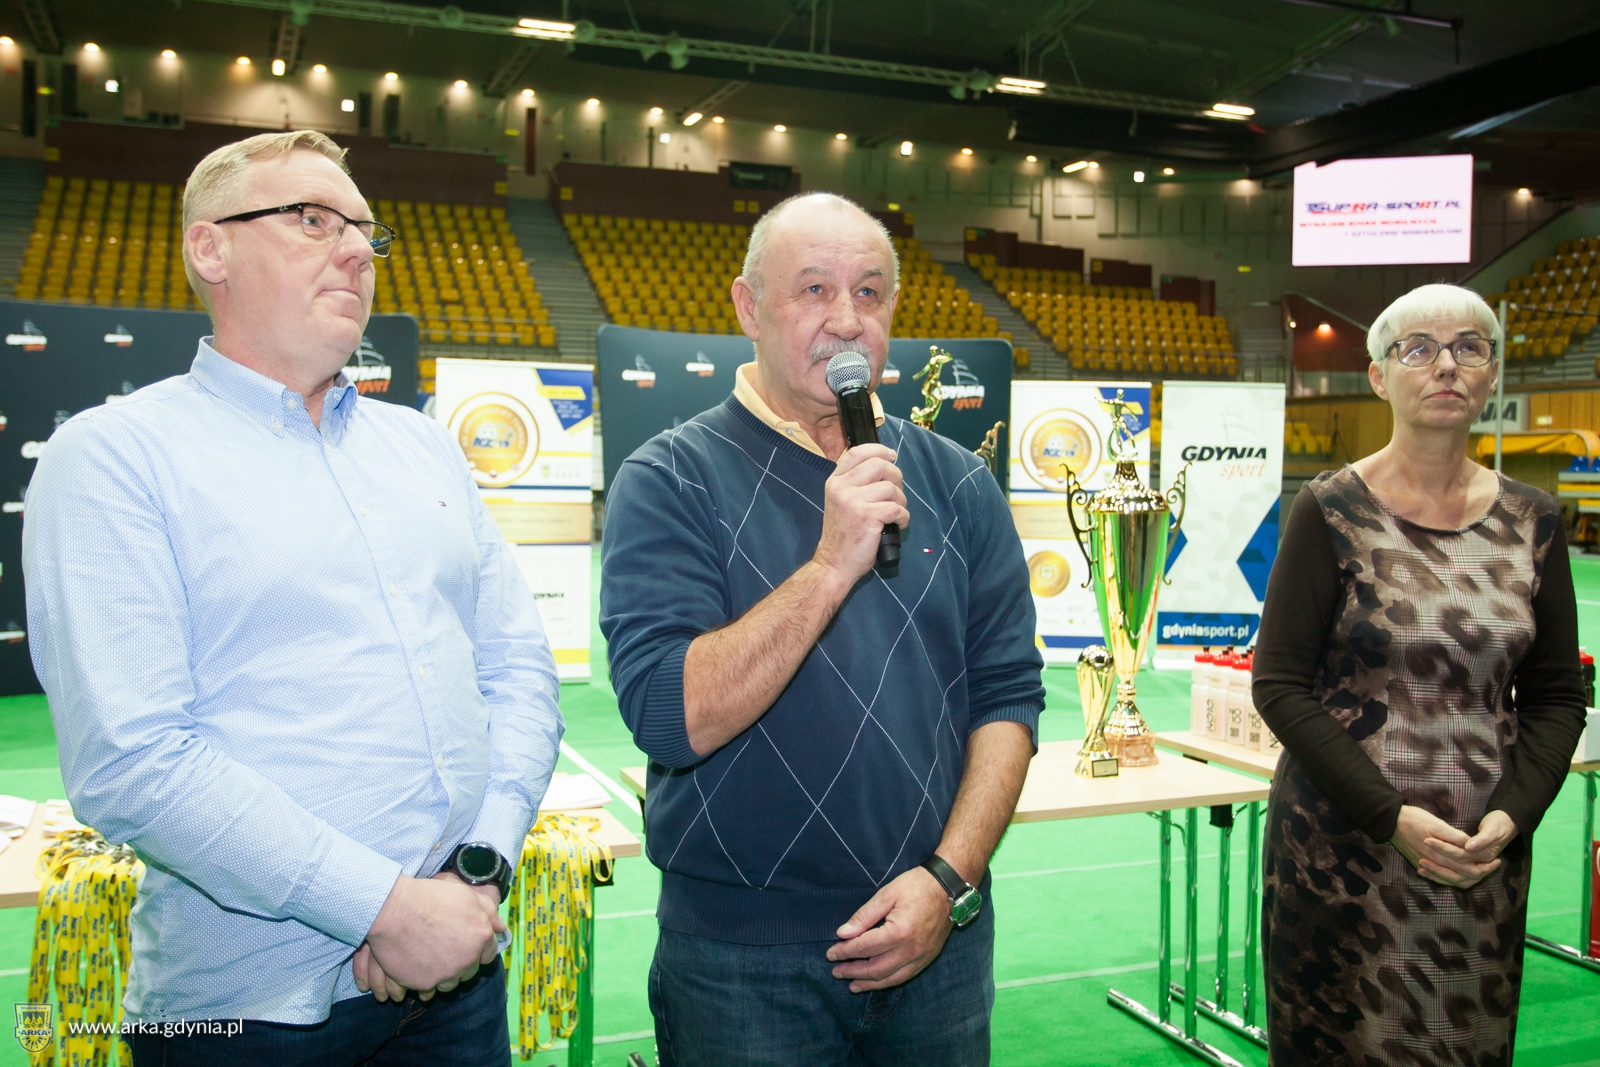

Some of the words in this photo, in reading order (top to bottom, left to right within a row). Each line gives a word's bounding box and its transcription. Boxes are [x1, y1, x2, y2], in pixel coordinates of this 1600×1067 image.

[1181, 445, 1267, 462] GDYNIA
[1220, 462, 1266, 480] sport
[1162, 623, 1249, 640] gdyniasport.pl
